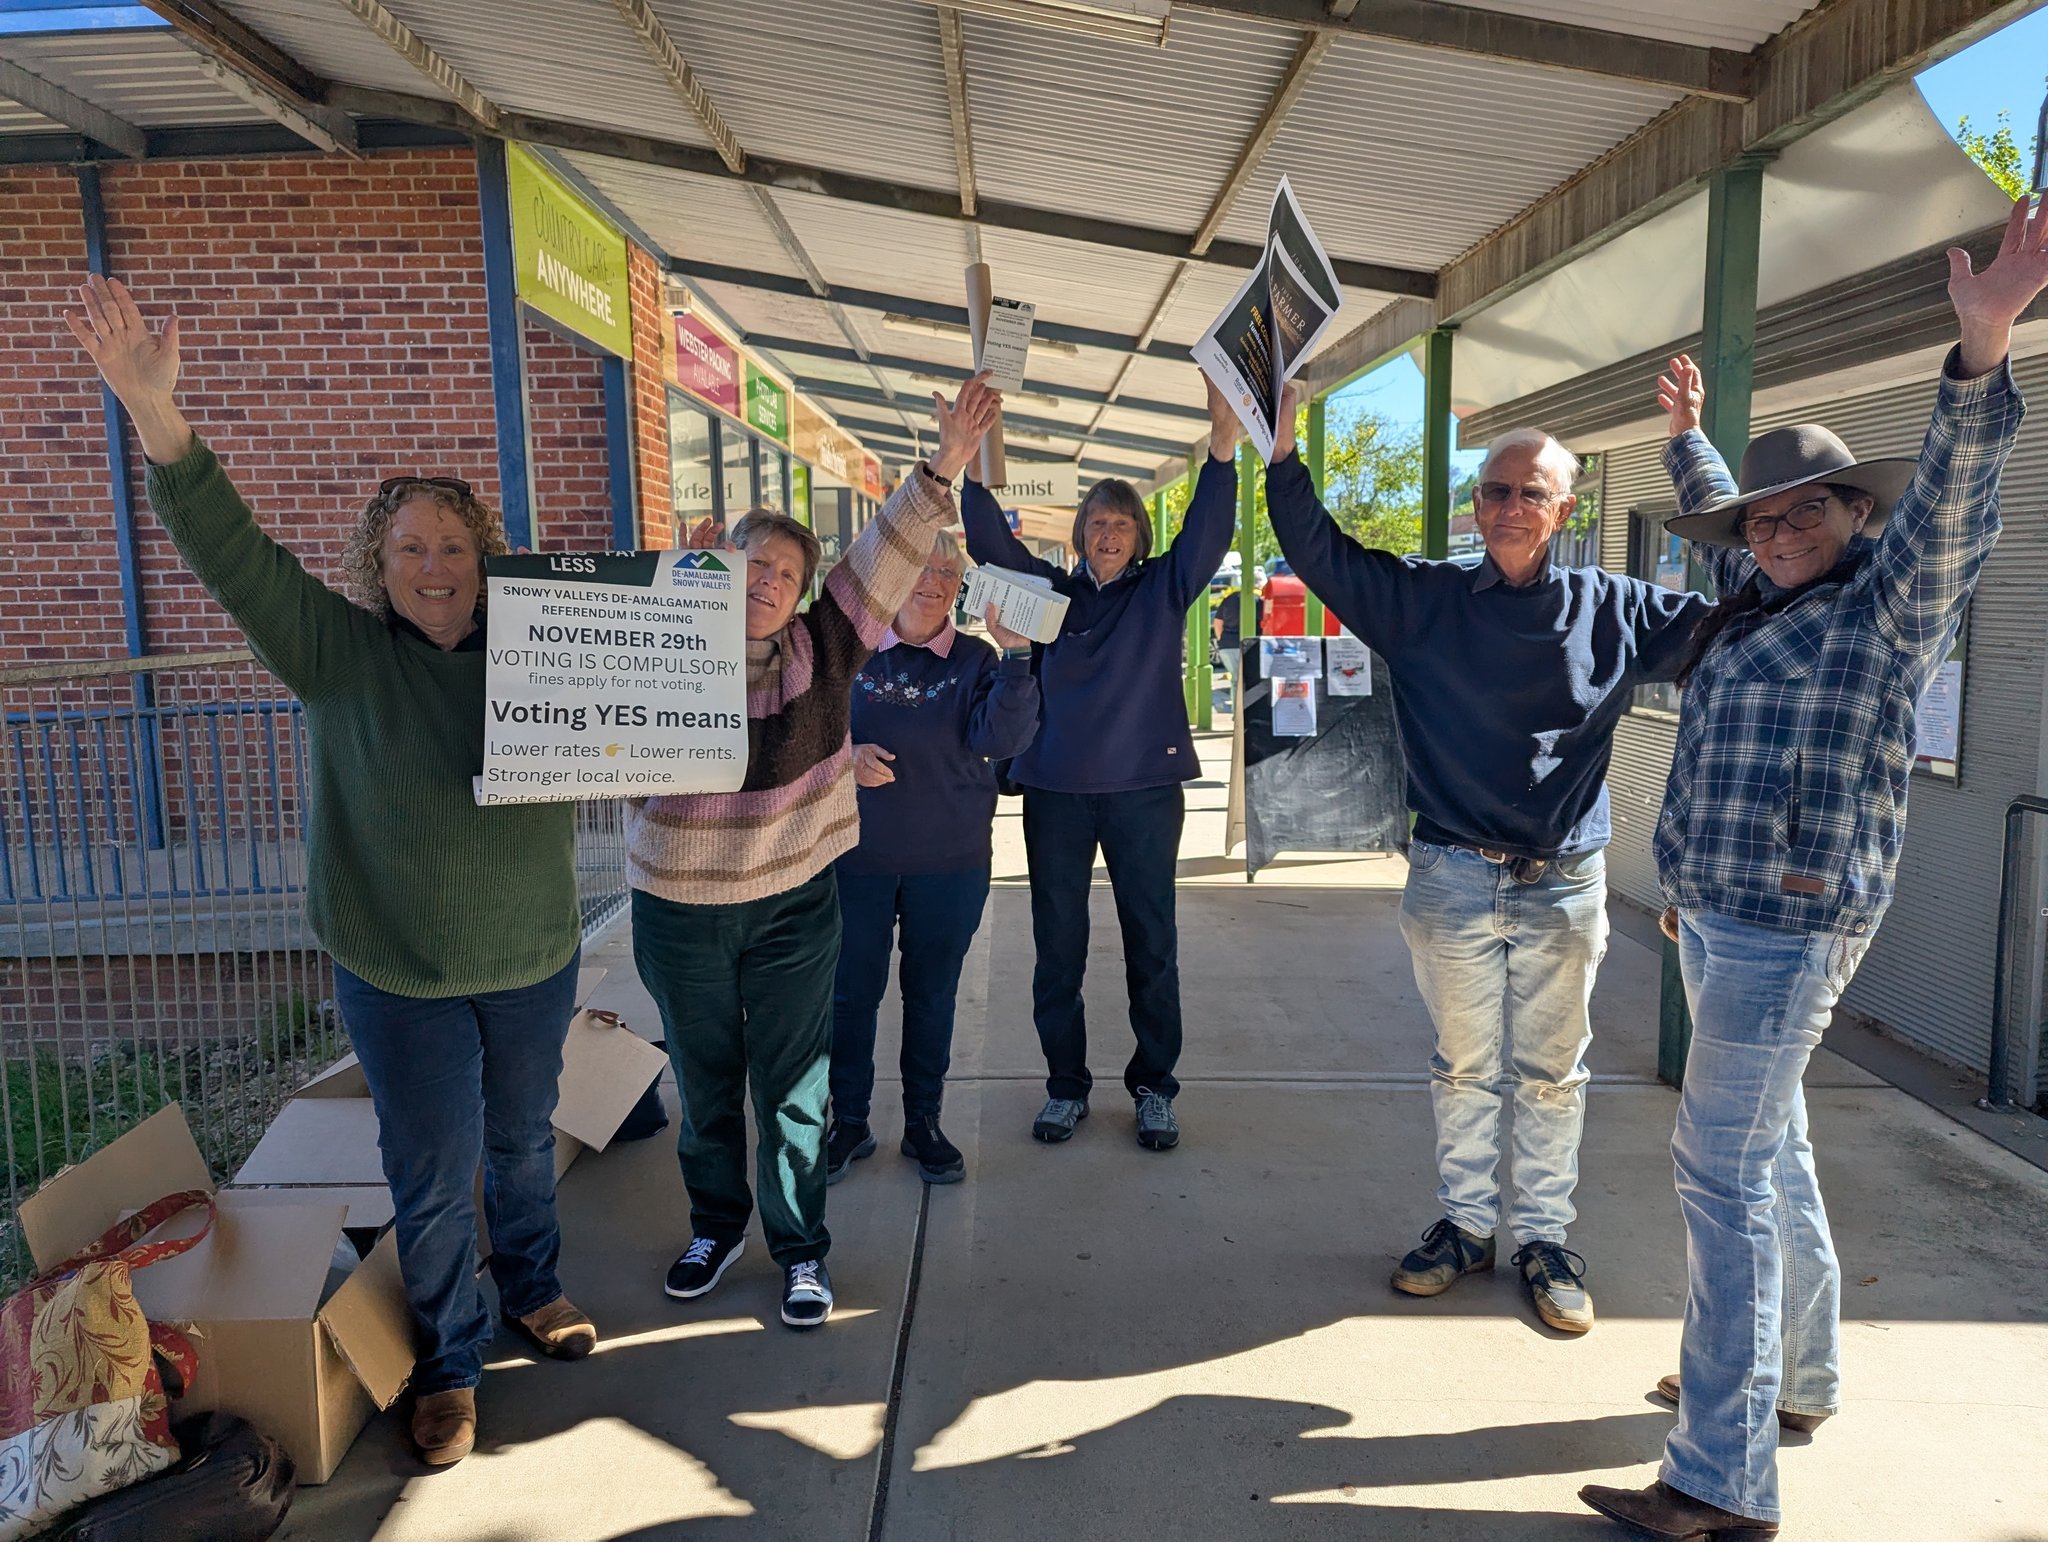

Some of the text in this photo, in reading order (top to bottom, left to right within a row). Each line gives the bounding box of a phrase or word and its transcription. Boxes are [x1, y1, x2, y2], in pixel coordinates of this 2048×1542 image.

[533, 197, 581, 267] COUNTRY
[538, 248, 616, 327] ANYWHERE.
[1250, 305, 1263, 327] FREE
[1271, 283, 1306, 332] FARMER
[678, 323, 708, 364] WEBSTER
[550, 556, 596, 574] LESS
[672, 570, 731, 582] DE-AMALGAMATE
[672, 578, 731, 591] SNOWY VALLEYS
[503, 585, 728, 612] SNOWY VALLEYS DE-AMALGAMATION
[541, 604, 693, 625] REFERENDUM IS COMING
[528, 624, 707, 651] NOVEMBER 29th
[489, 649, 738, 676] VOTING IS COMPULSORY
[528, 671, 706, 694] fines apply for not voting.
[491, 700, 742, 731] Voting YES means
[490, 741, 600, 757] Lower rates
[630, 743, 736, 760] Lower rents.
[488, 767, 675, 786] Stronger local voice.
